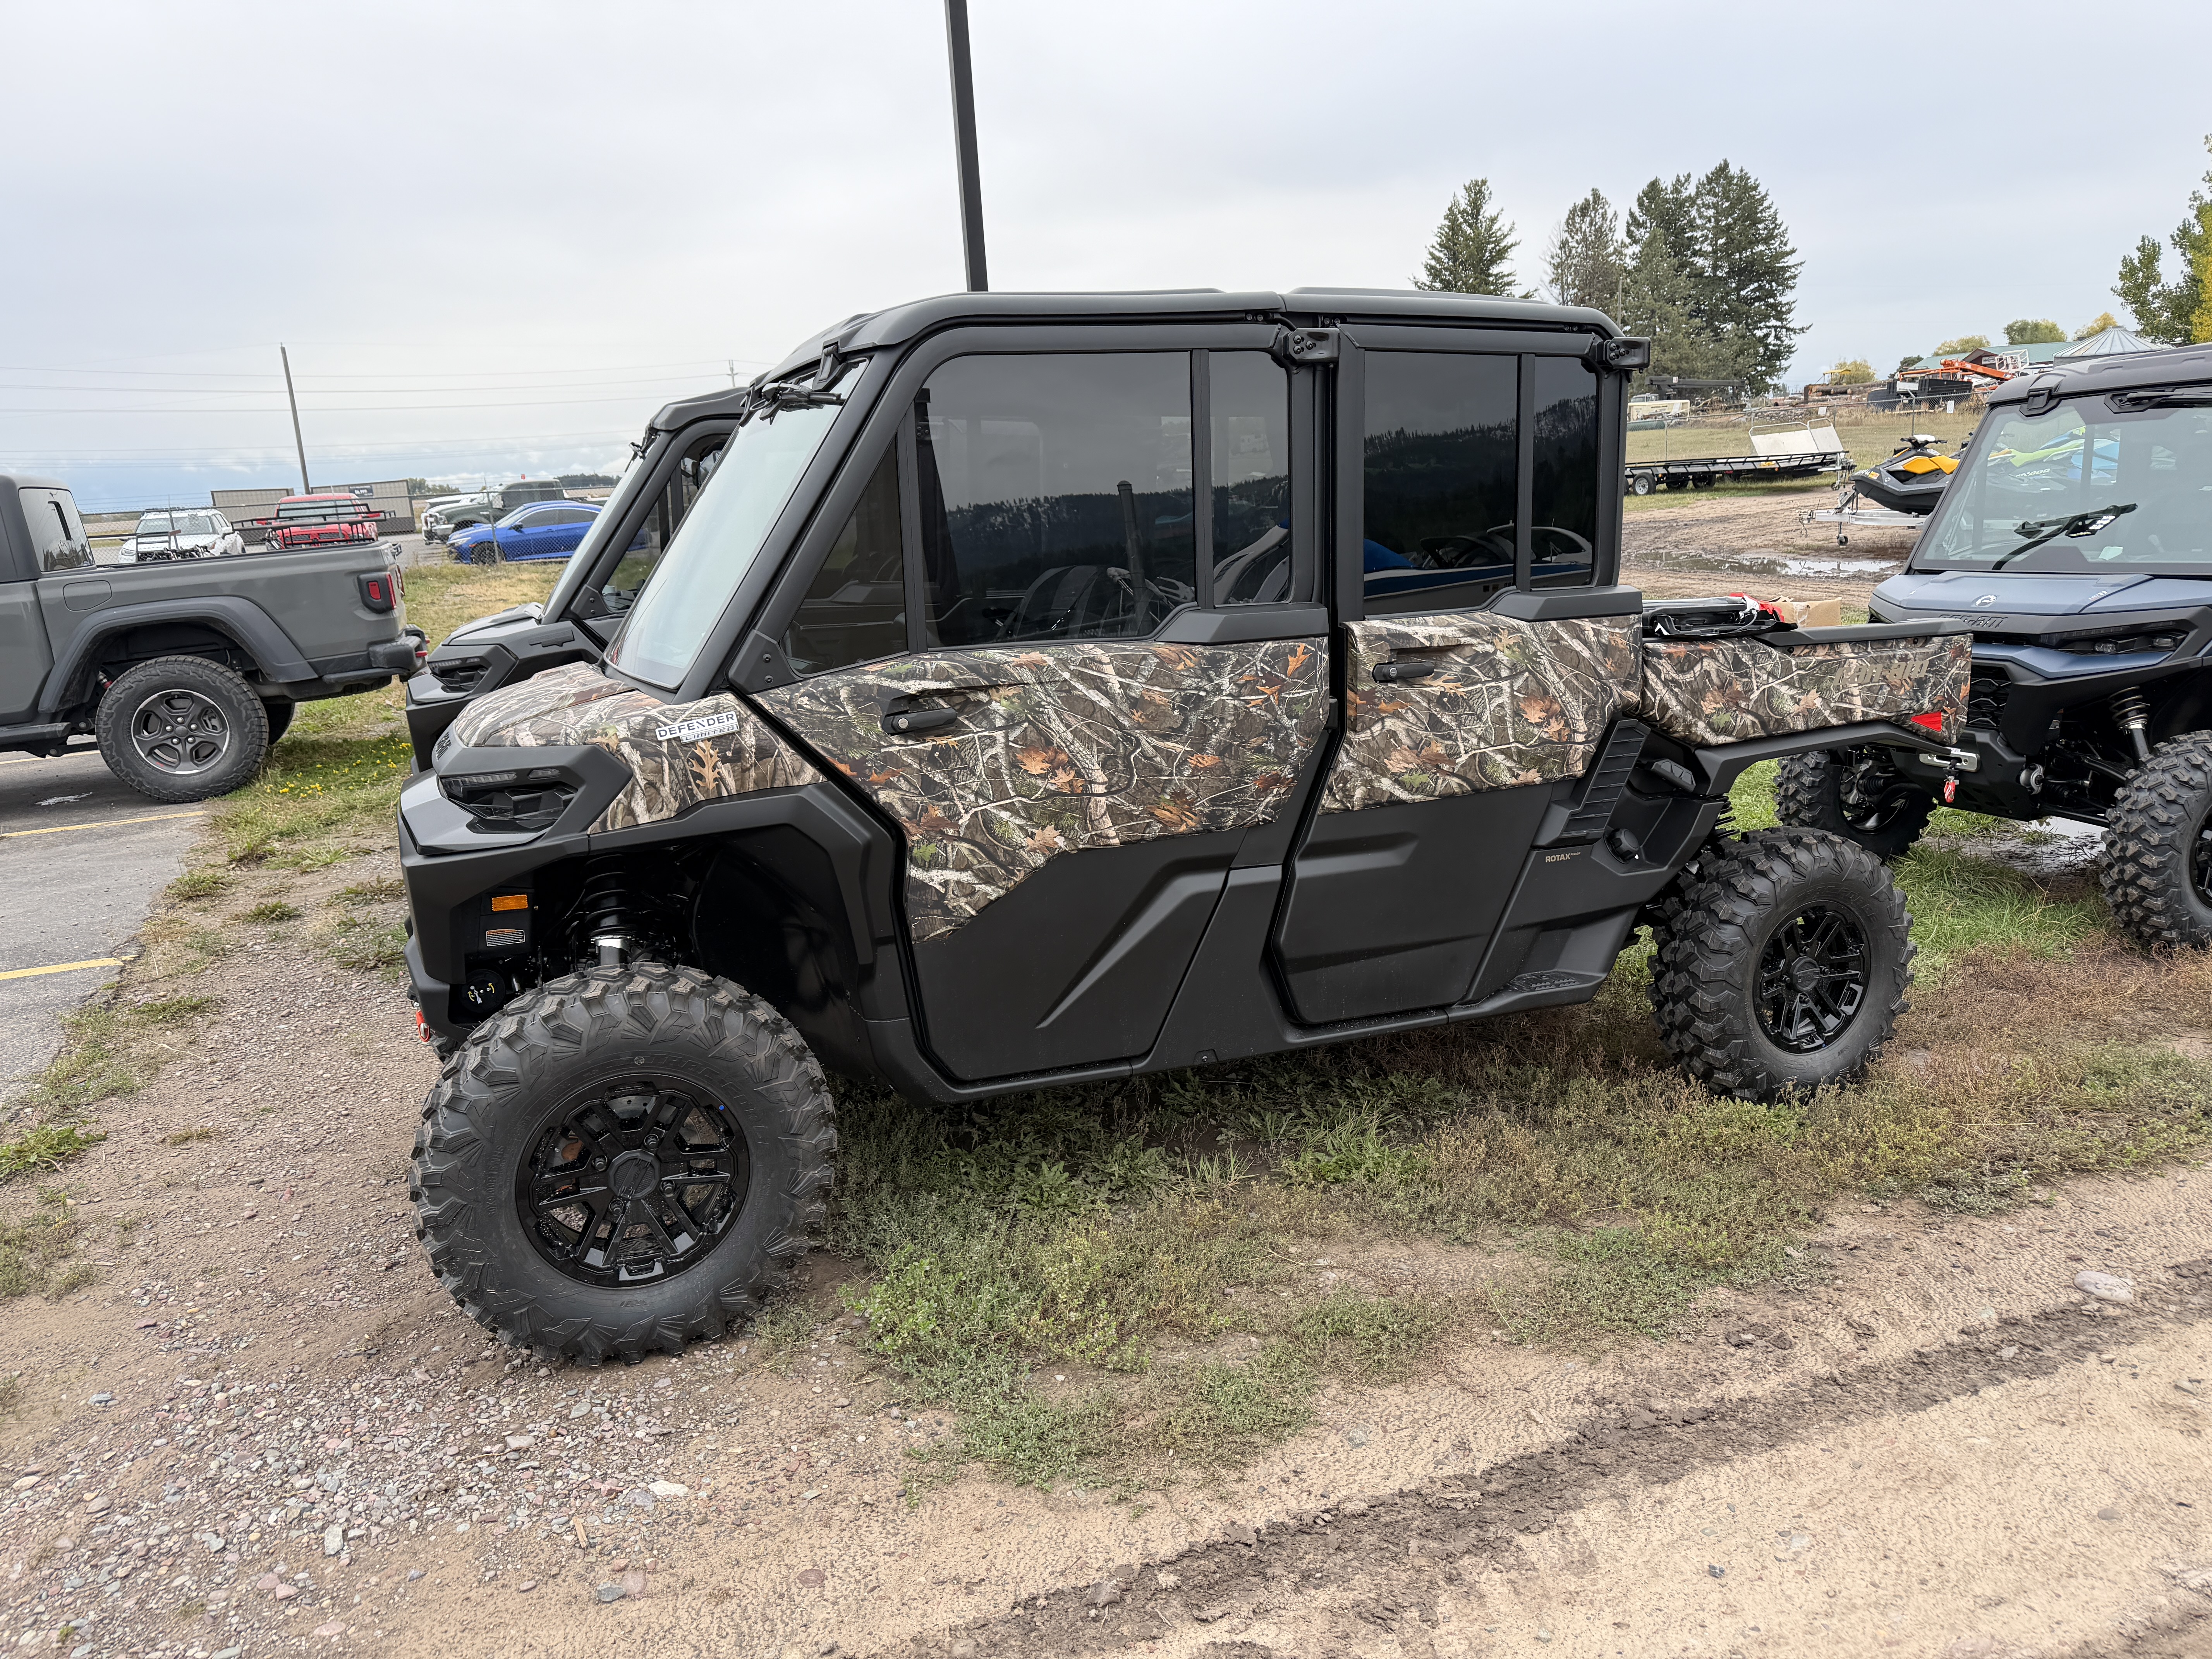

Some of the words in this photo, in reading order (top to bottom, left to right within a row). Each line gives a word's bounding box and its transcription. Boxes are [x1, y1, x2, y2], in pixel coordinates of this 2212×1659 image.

[1832, 660, 1929, 686] can-am
[658, 713, 735, 738] DEFENDER
[685, 726, 735, 741] LIMITED
[1546, 853, 1570, 862] ROTAX
